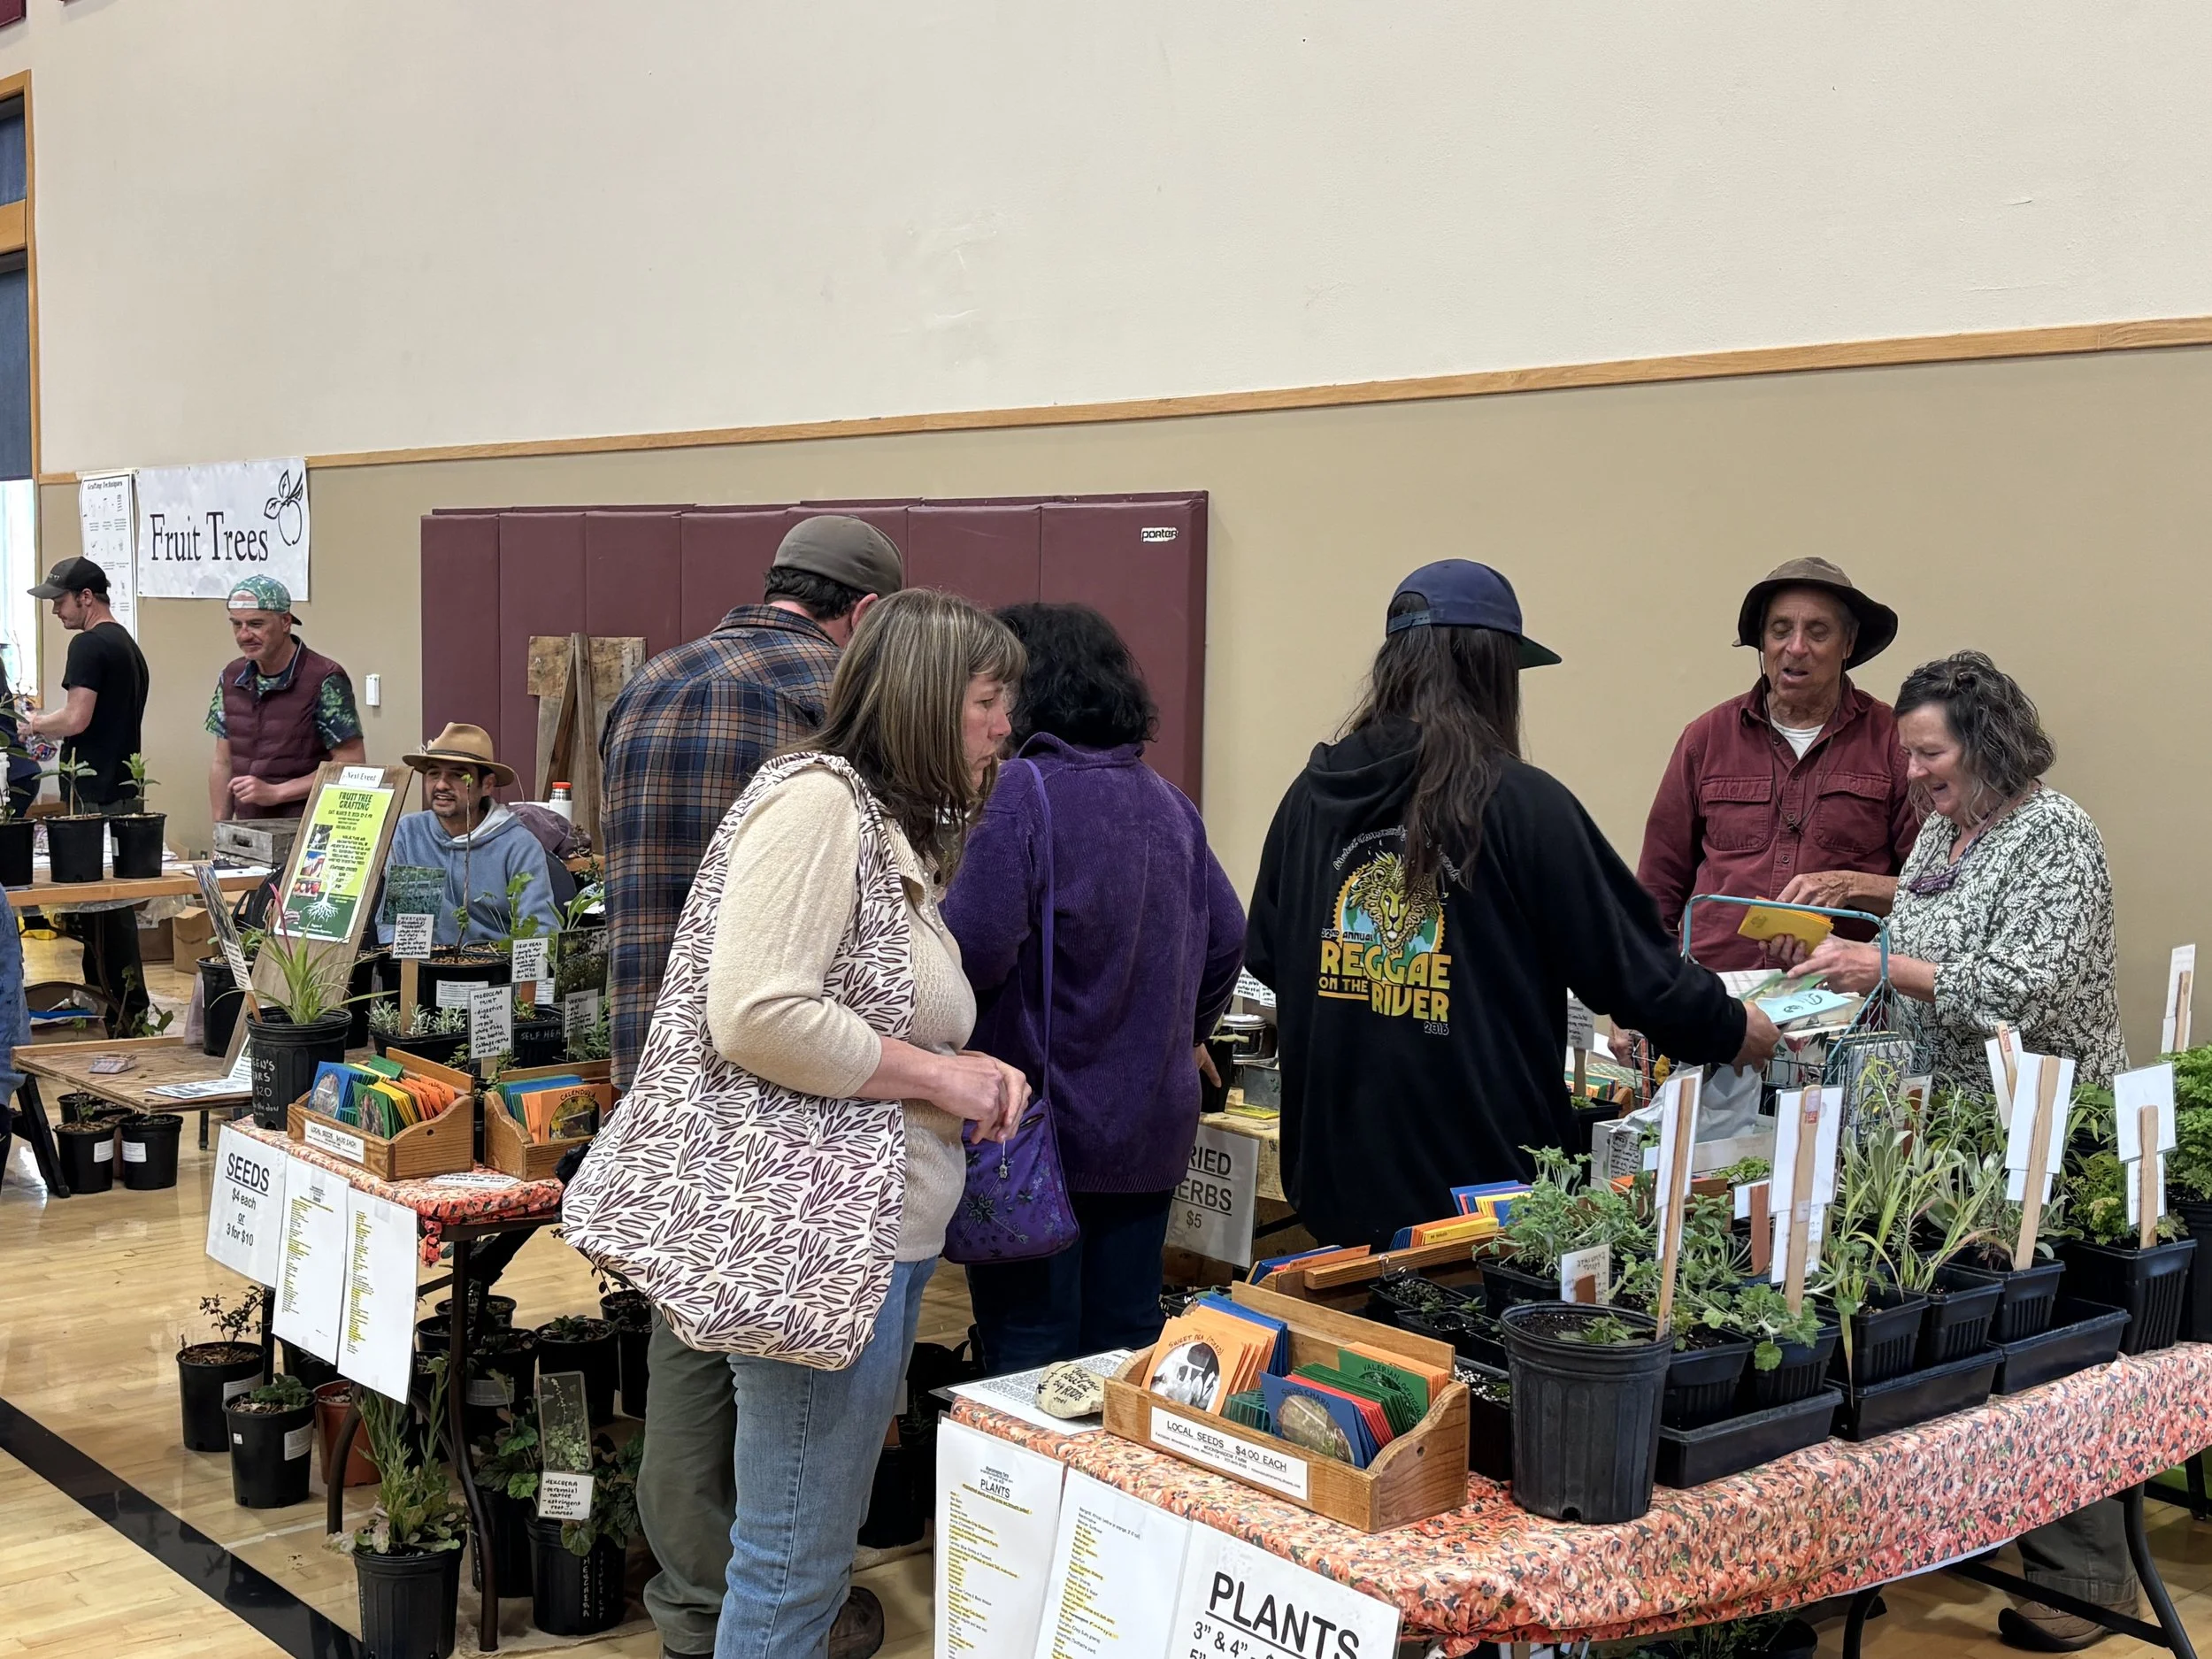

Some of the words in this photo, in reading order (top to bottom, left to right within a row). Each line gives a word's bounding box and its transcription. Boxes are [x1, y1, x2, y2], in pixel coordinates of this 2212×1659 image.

[150, 514, 201, 561] Fruit
[206, 511, 268, 562] Trees
[360, 772, 377, 781] Event
[339, 792, 357, 802] FRUIT
[358, 793, 373, 803] TREE
[339, 800, 370, 811] GRAFTING
[1342, 931, 1374, 942] ANNUAL
[1320, 941, 1452, 990] REGGAE
[1318, 977, 1338, 990] ON
[1342, 978, 1369, 993] THE
[1371, 982, 1449, 1023] RIVER
[520, 1031, 541, 1041] SELF
[543, 1029, 562, 1039] HEA
[560, 1089, 595, 1100] CALENDULA
[1189, 1146, 1232, 1176] RIED
[227, 1152, 270, 1192] SEEDS
[232, 1187, 241, 1202] $4
[241, 1194, 257, 1210] each
[1178, 1178, 1233, 1211] ERBS
[238, 1212, 246, 1223] or
[1187, 1210, 1202, 1229] $5
[227, 1223, 231, 1236] 3
[231, 1225, 241, 1240] for
[242, 1230, 254, 1247] $10
[1168, 1334, 1193, 1348] SWEET
[1304, 1389, 1332, 1410] CHARD
[1167, 1420, 1193, 1437] LOCAL
[1197, 1432, 1225, 1448] SEEDS
[1263, 1455, 1287, 1471] EACH
[980, 1479, 1010, 1498] PLANTS
[1209, 1571, 1359, 1659] PLANTS
[1214, 1631, 1225, 1652] &
